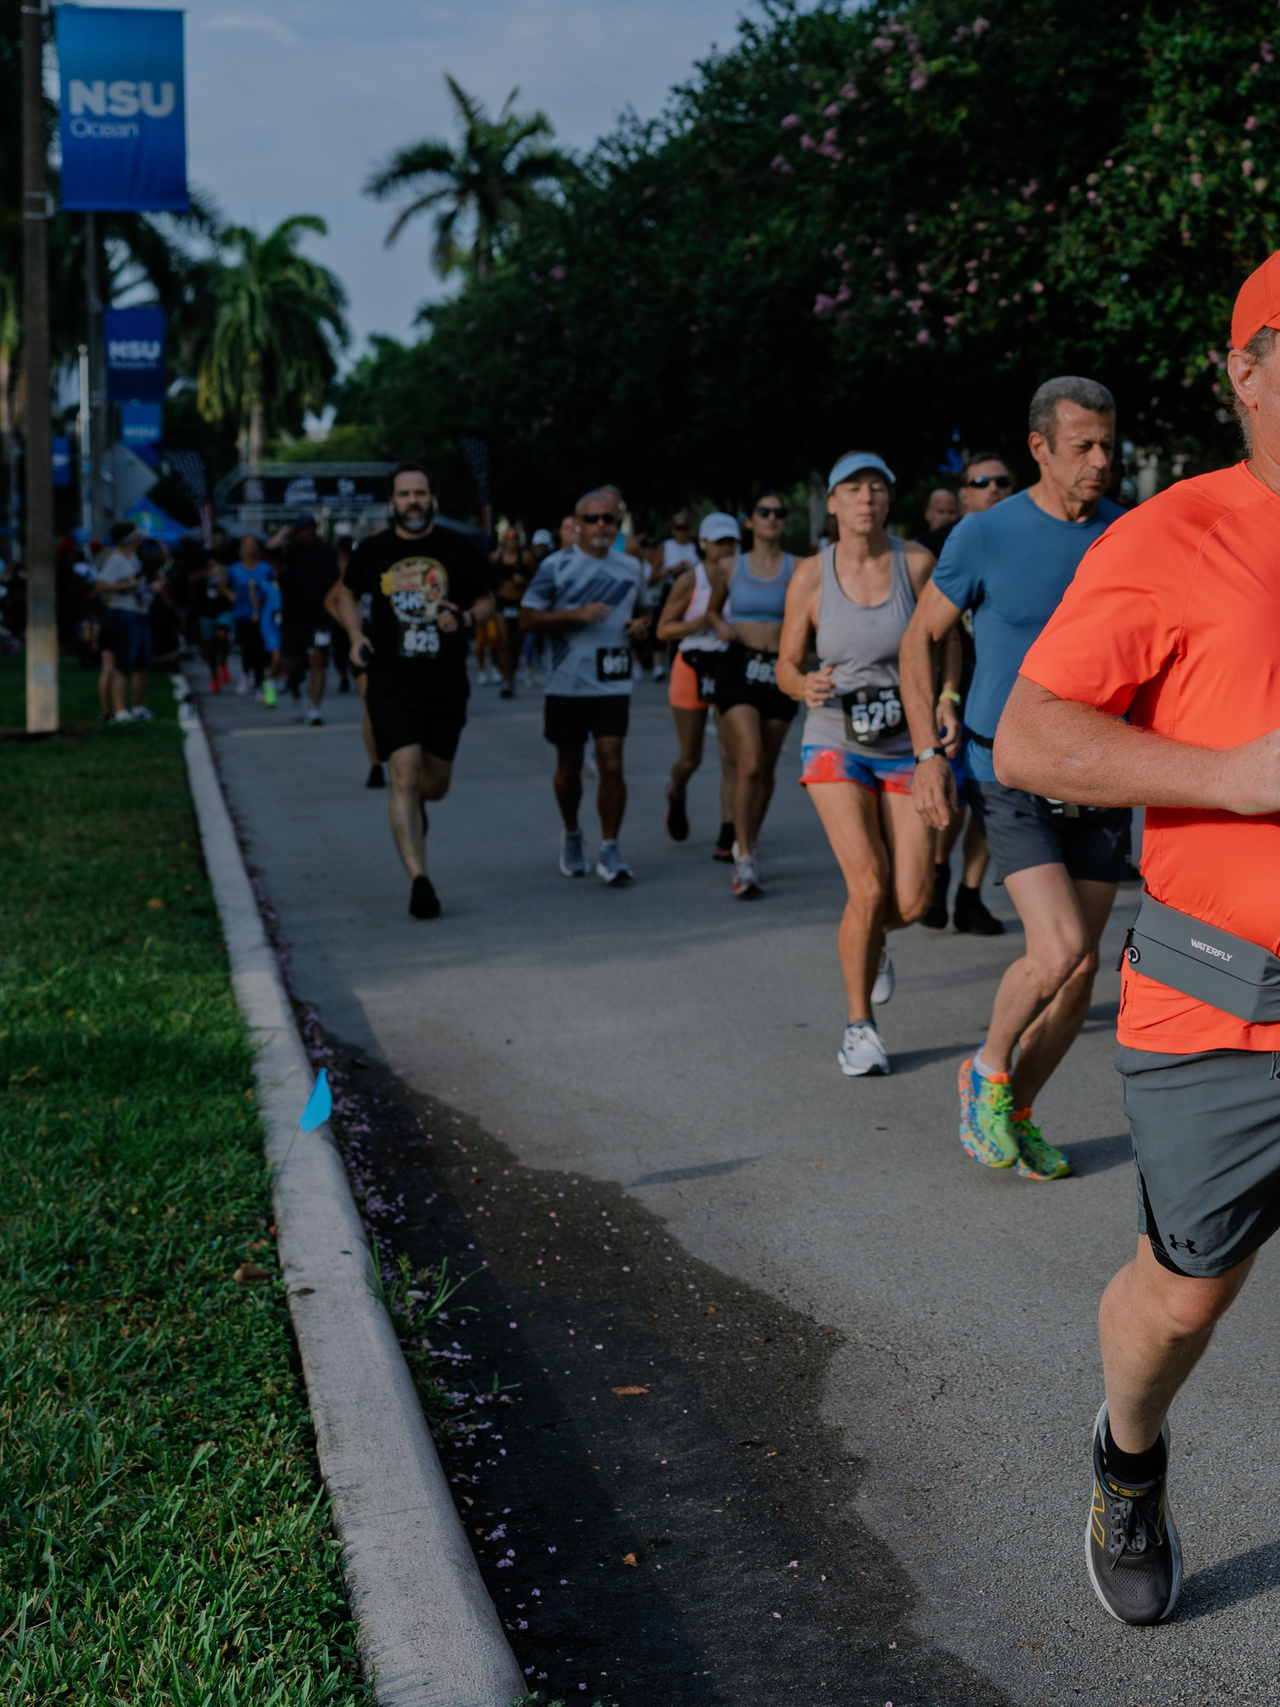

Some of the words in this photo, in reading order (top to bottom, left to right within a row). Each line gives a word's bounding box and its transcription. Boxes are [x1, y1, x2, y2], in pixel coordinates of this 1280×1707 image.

[68, 79, 175, 118] NSU
[69, 117, 139, 139] Ocean
[107, 339, 161, 361] NSU
[403, 628, 440, 654] 825
[851, 699, 902, 734] 526
[1191, 938, 1233, 962] WATERFLY
